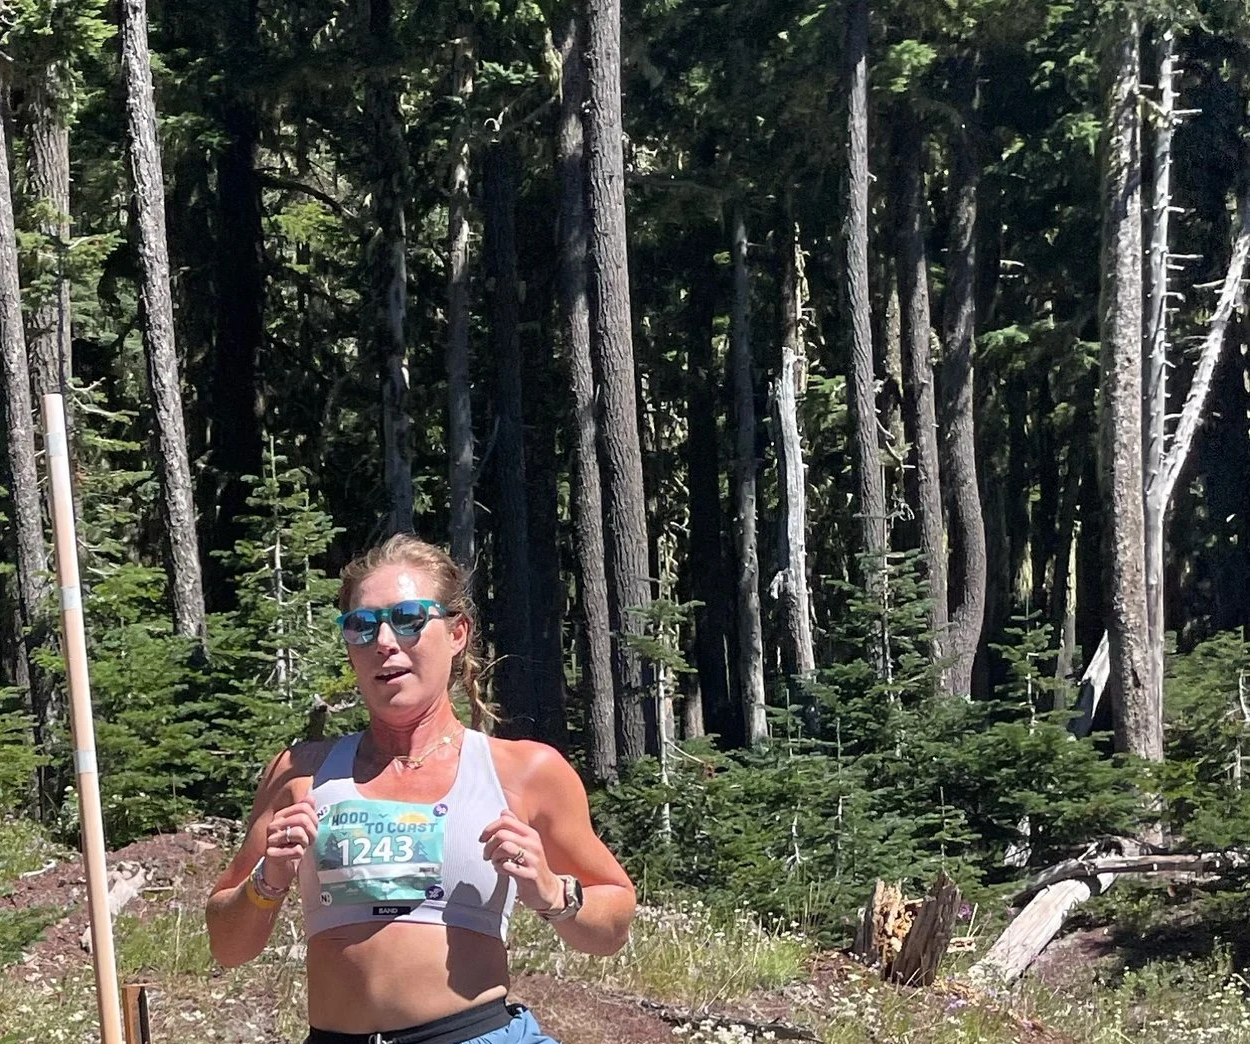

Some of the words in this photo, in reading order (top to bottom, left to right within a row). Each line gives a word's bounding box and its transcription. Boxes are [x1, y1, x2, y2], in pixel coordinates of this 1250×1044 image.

[332, 811, 369, 826] HOOD
[365, 822, 385, 834] TO
[387, 822, 439, 834] COAST
[337, 835, 414, 866] 1243
